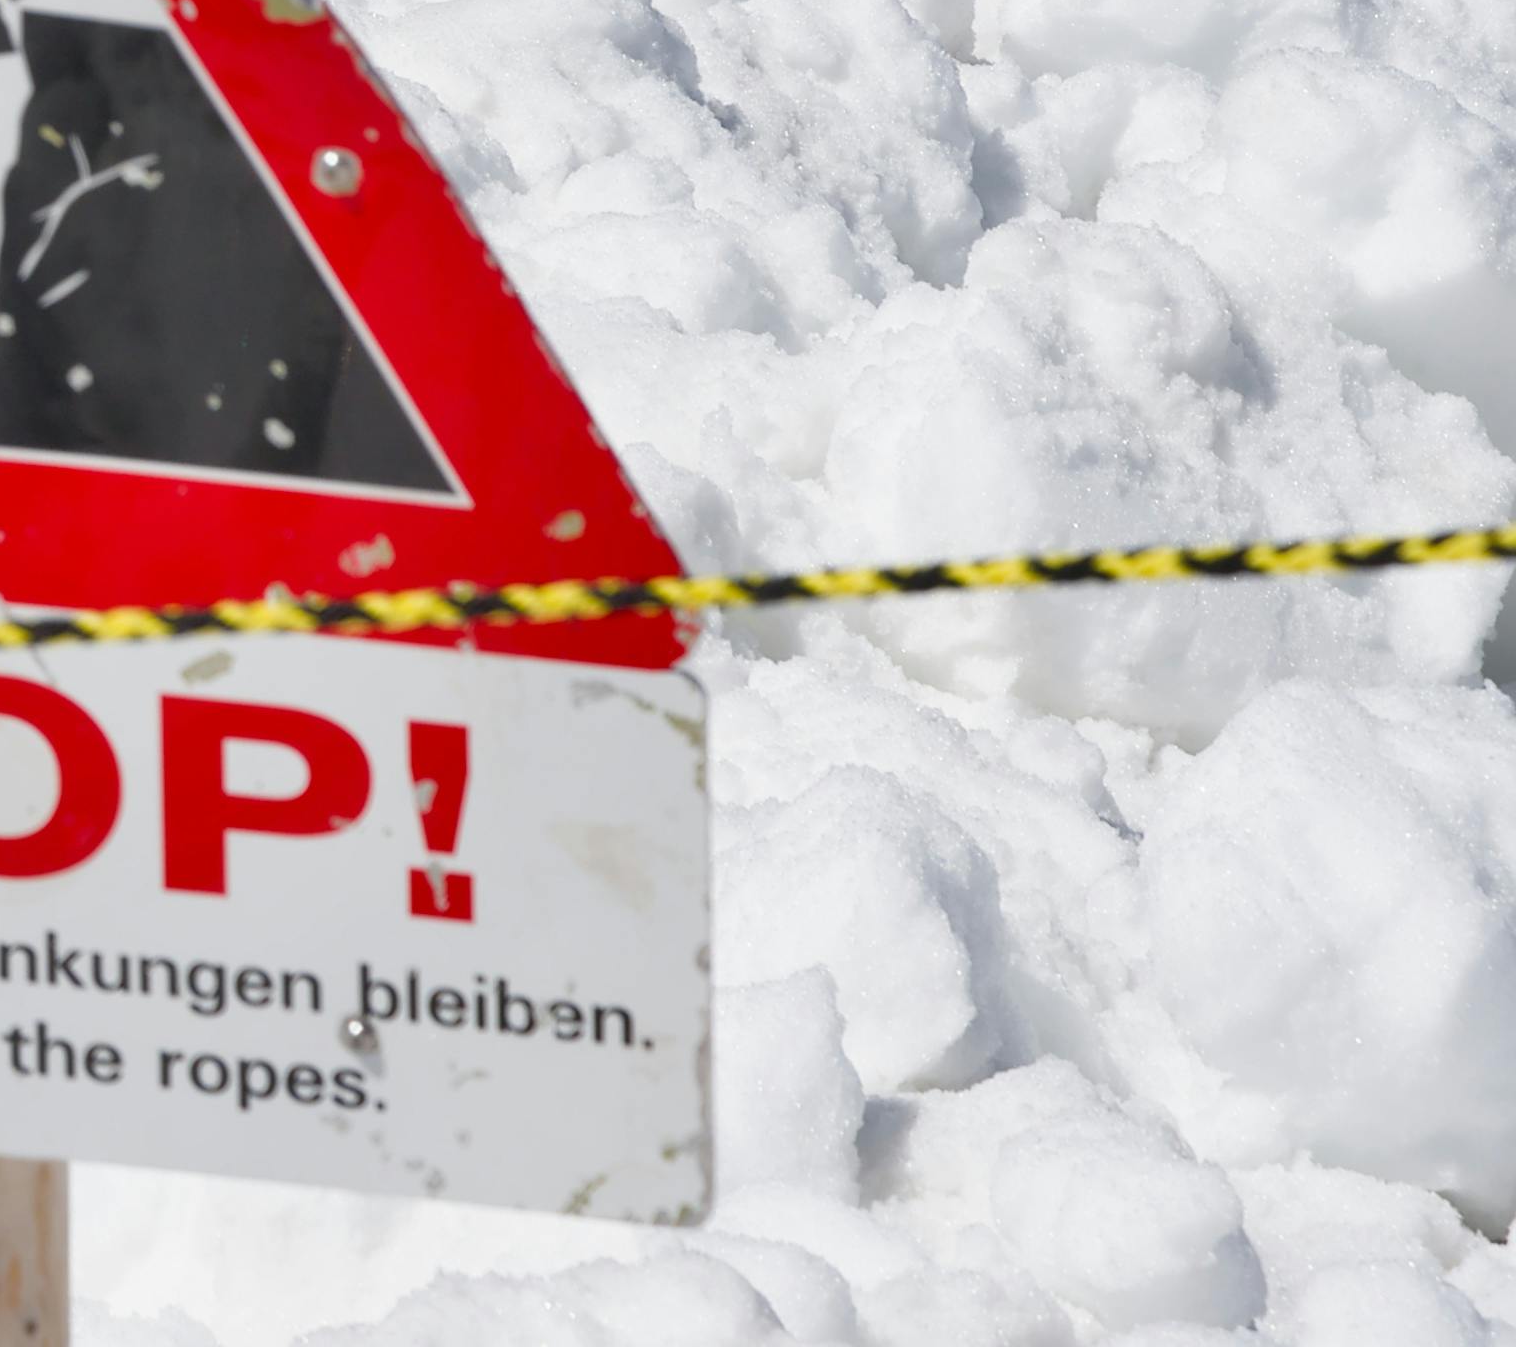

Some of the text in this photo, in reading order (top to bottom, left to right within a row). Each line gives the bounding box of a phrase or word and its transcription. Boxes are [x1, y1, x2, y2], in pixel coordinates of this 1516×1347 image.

[358, 961, 657, 1052] bleiben.
[3, 1022, 124, 1083] the
[158, 1046, 389, 1111] ropes.
